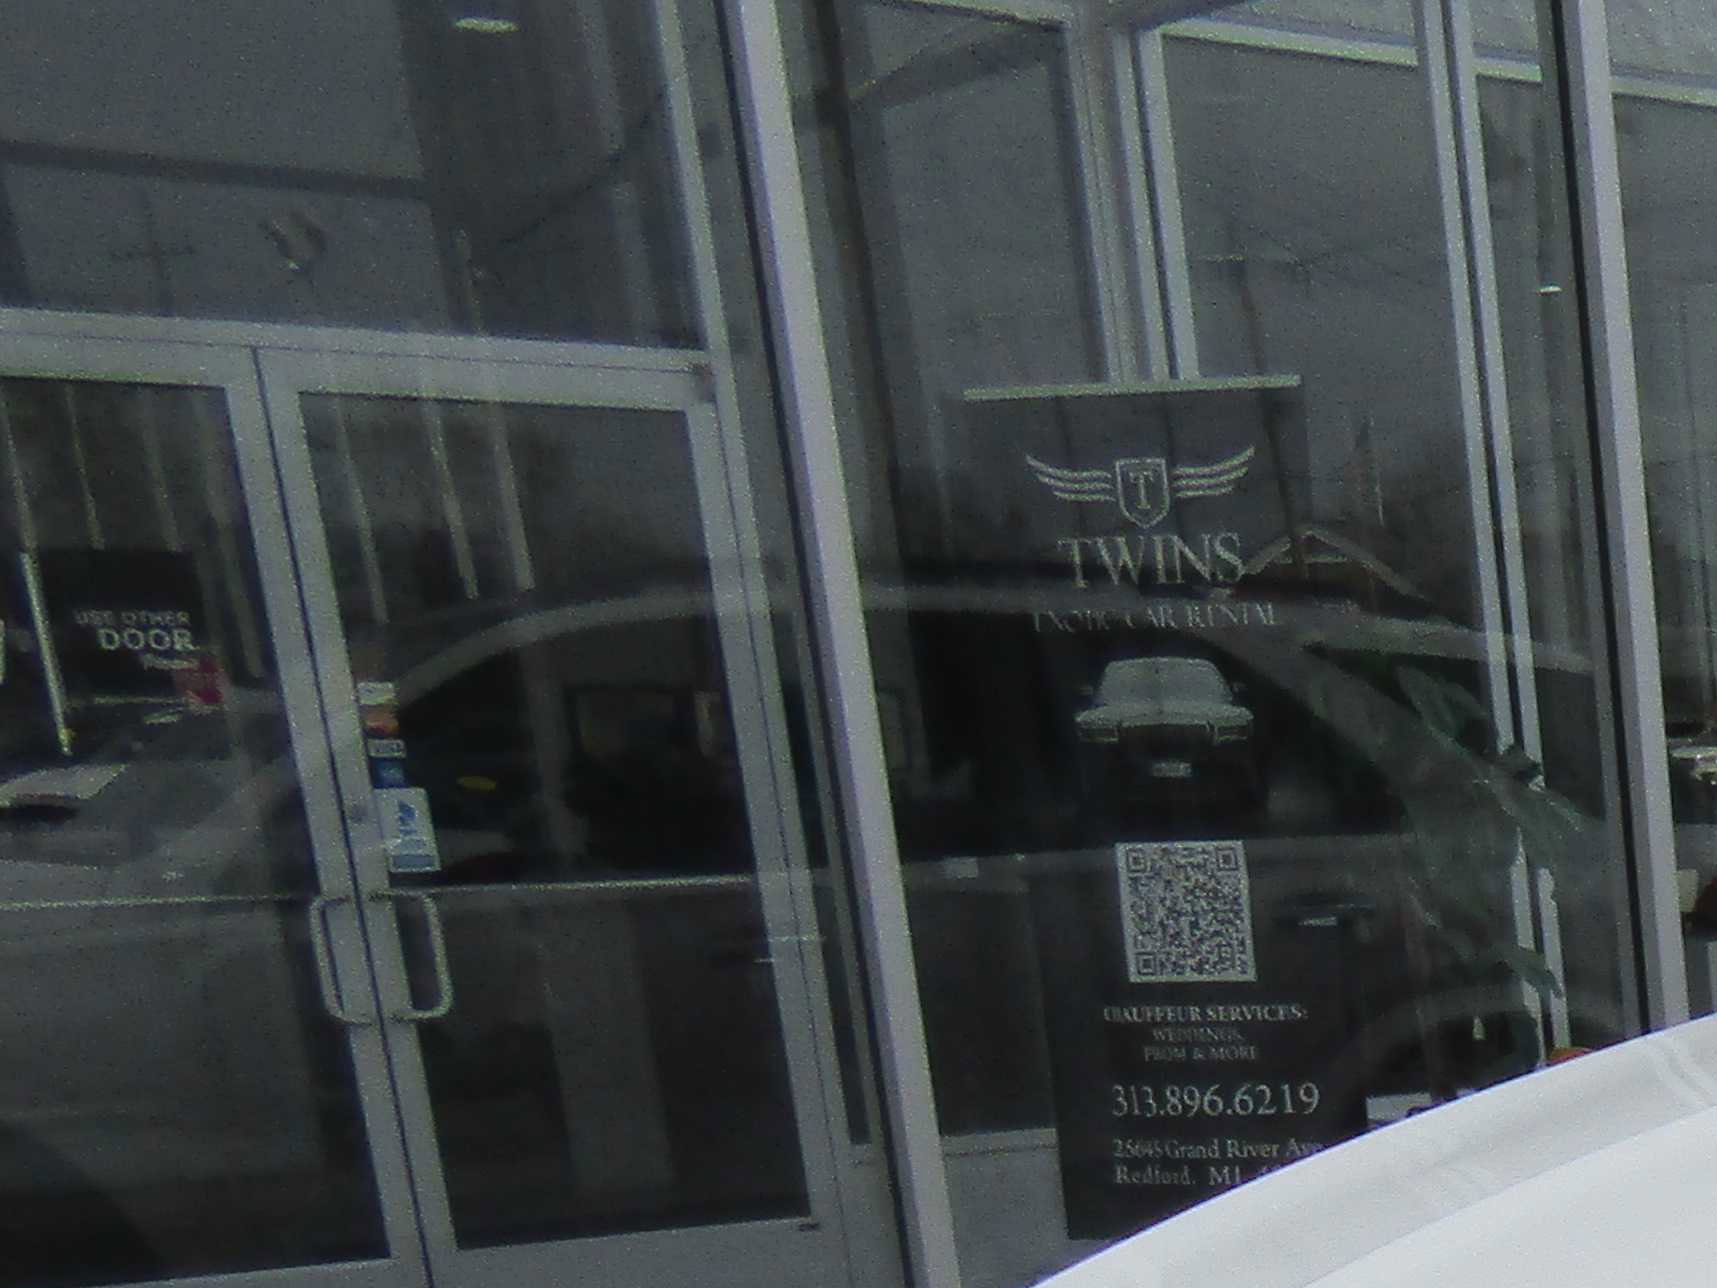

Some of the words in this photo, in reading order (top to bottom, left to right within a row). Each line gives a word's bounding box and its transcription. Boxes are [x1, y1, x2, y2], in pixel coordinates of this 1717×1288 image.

[1057, 532, 1244, 588] TWINS
[97, 627, 196, 651] DOOR
[1111, 1081, 1321, 1118] 313.896.6219
[1165, 1137, 1221, 1160] Grand
[1226, 1137, 1281, 1160] River
